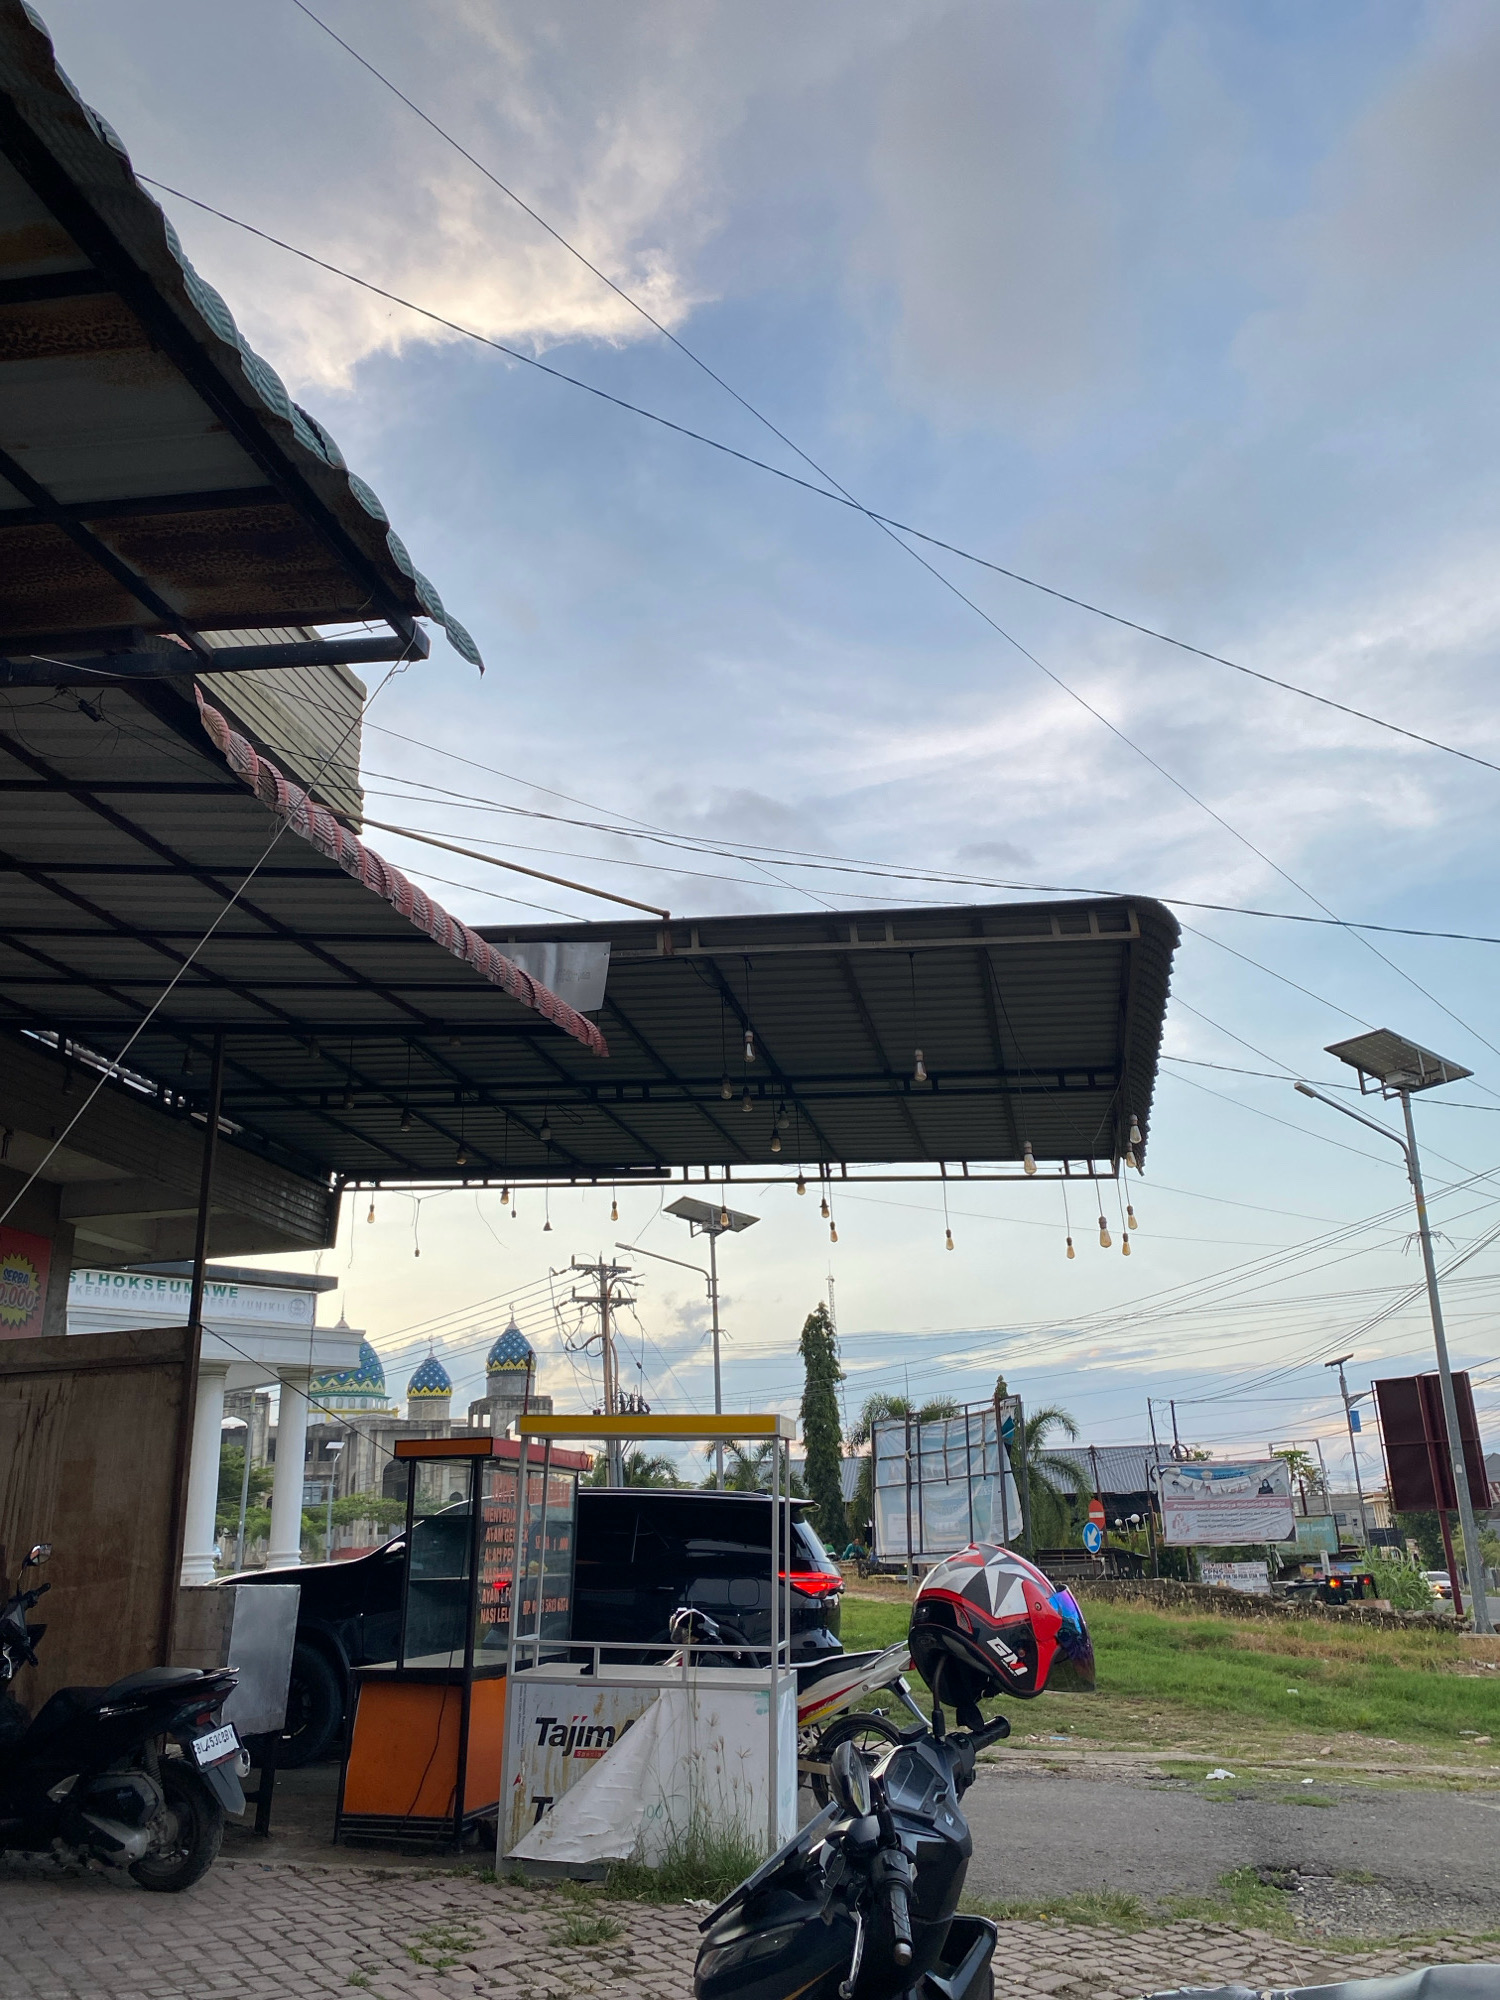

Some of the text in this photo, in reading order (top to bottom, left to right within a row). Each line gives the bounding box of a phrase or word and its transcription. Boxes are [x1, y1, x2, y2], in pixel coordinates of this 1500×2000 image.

[3, 1267, 30, 1285] SERBA
[75, 1285, 165, 1301] KEBANGSAAN
[168, 1294, 238, 1307] INDNESIA
[480, 1607, 511, 1624] NASI LEL
[986, 1636, 1028, 1676] GM
